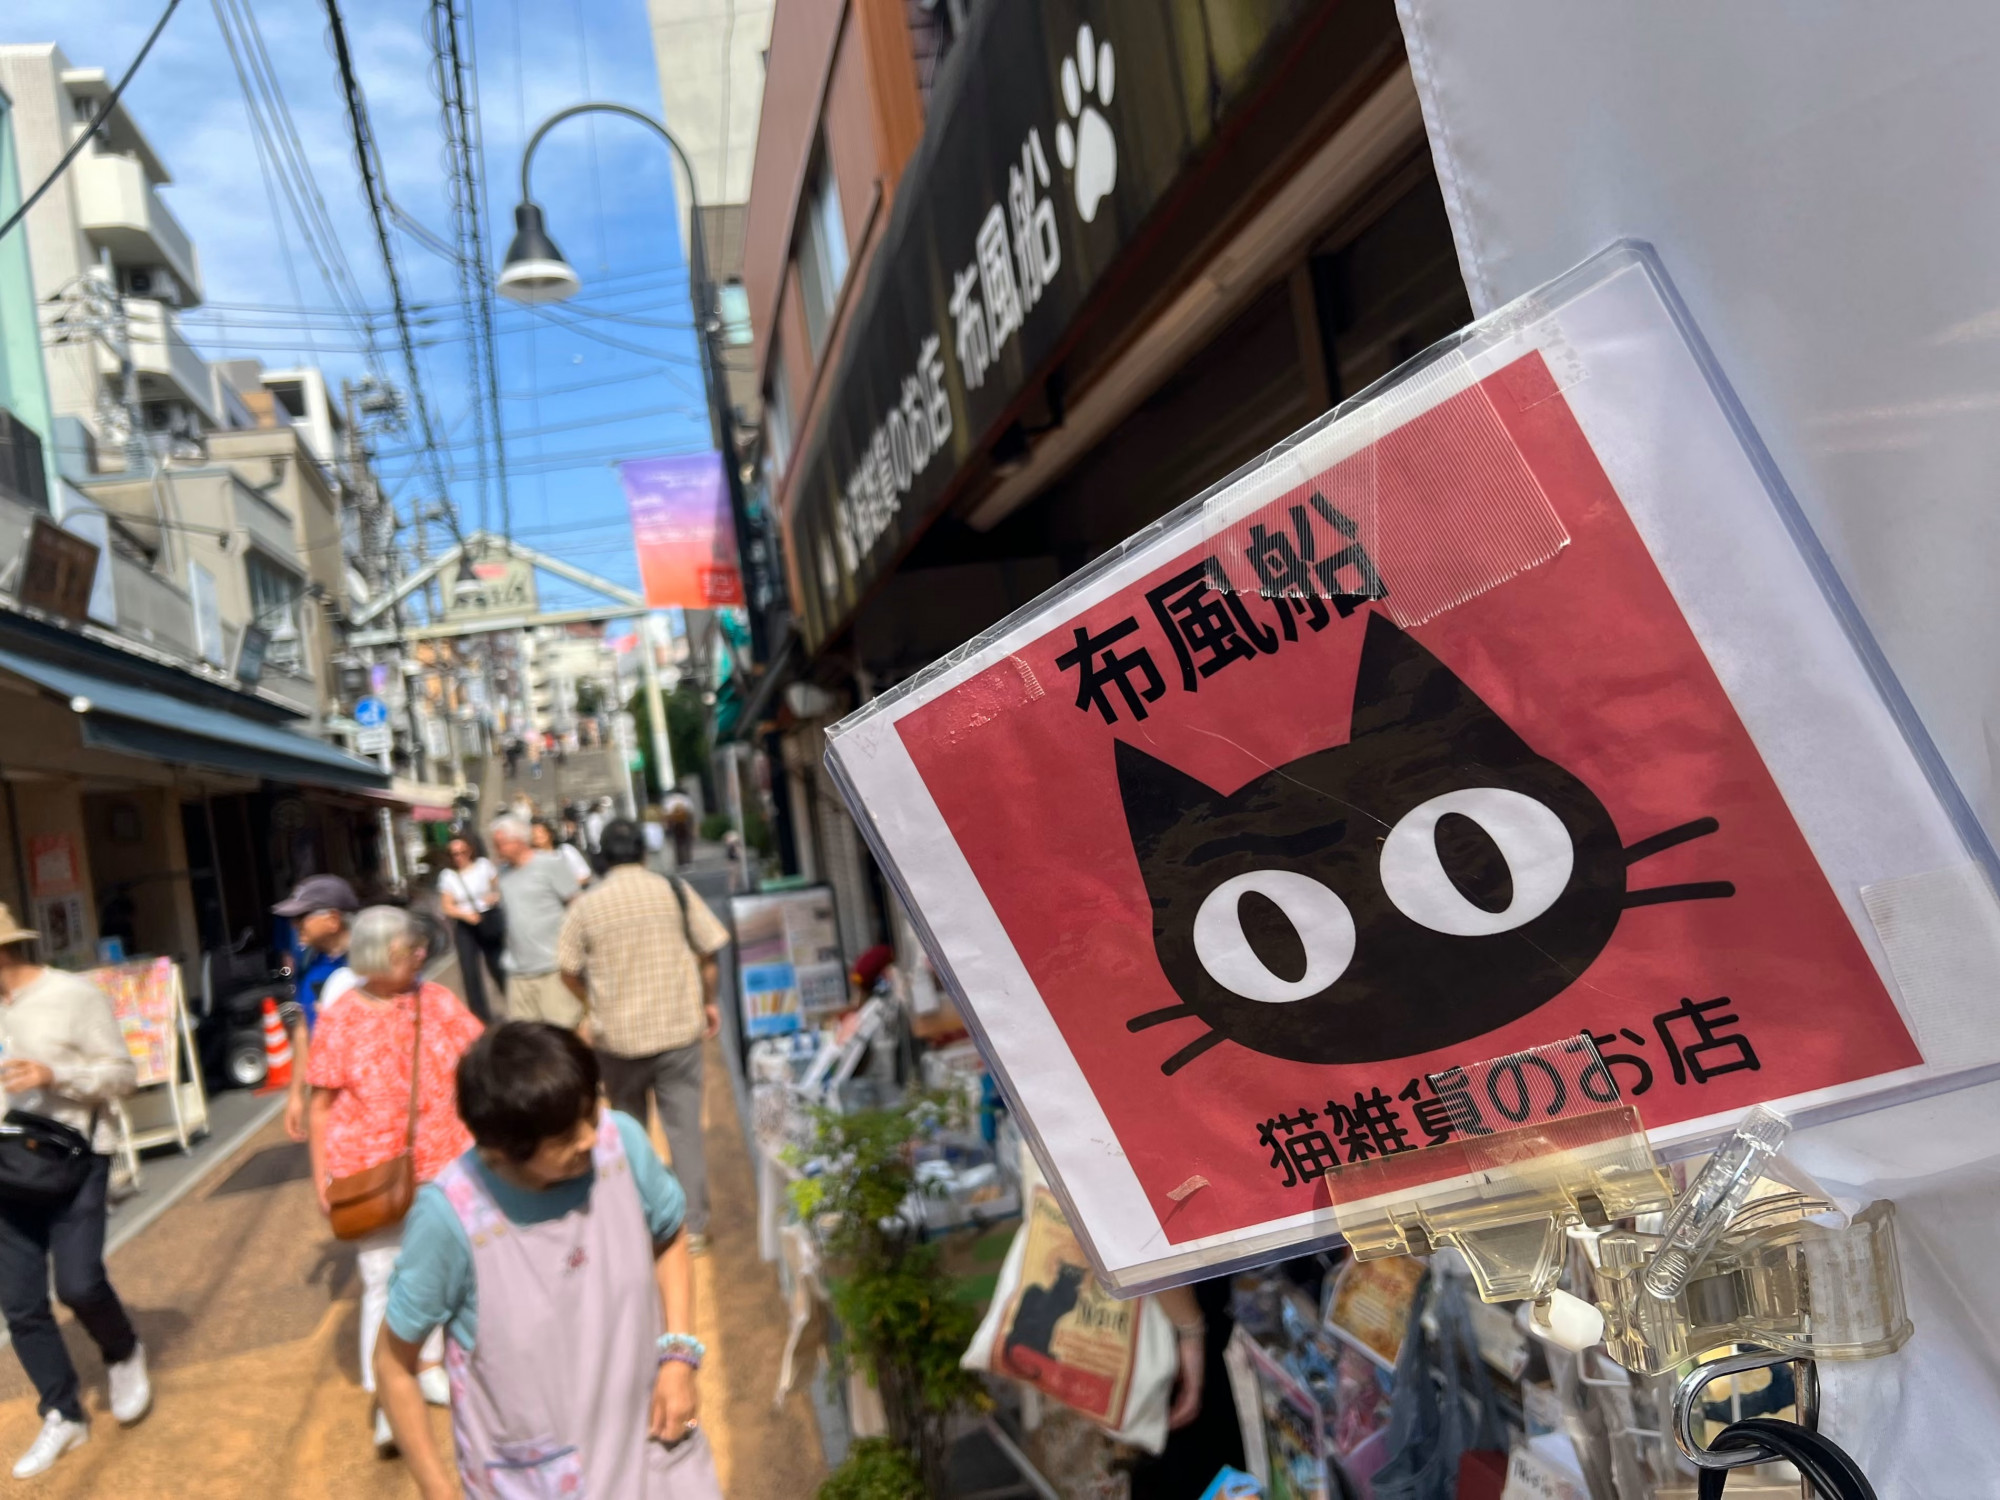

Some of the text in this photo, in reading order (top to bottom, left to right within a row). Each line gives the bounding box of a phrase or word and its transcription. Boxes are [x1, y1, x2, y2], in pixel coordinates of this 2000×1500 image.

[947, 127, 1061, 390] 布風船
[1055, 490, 1387, 726] 布風船
[1256, 996, 1761, 1188] 猫雑貨のお店
